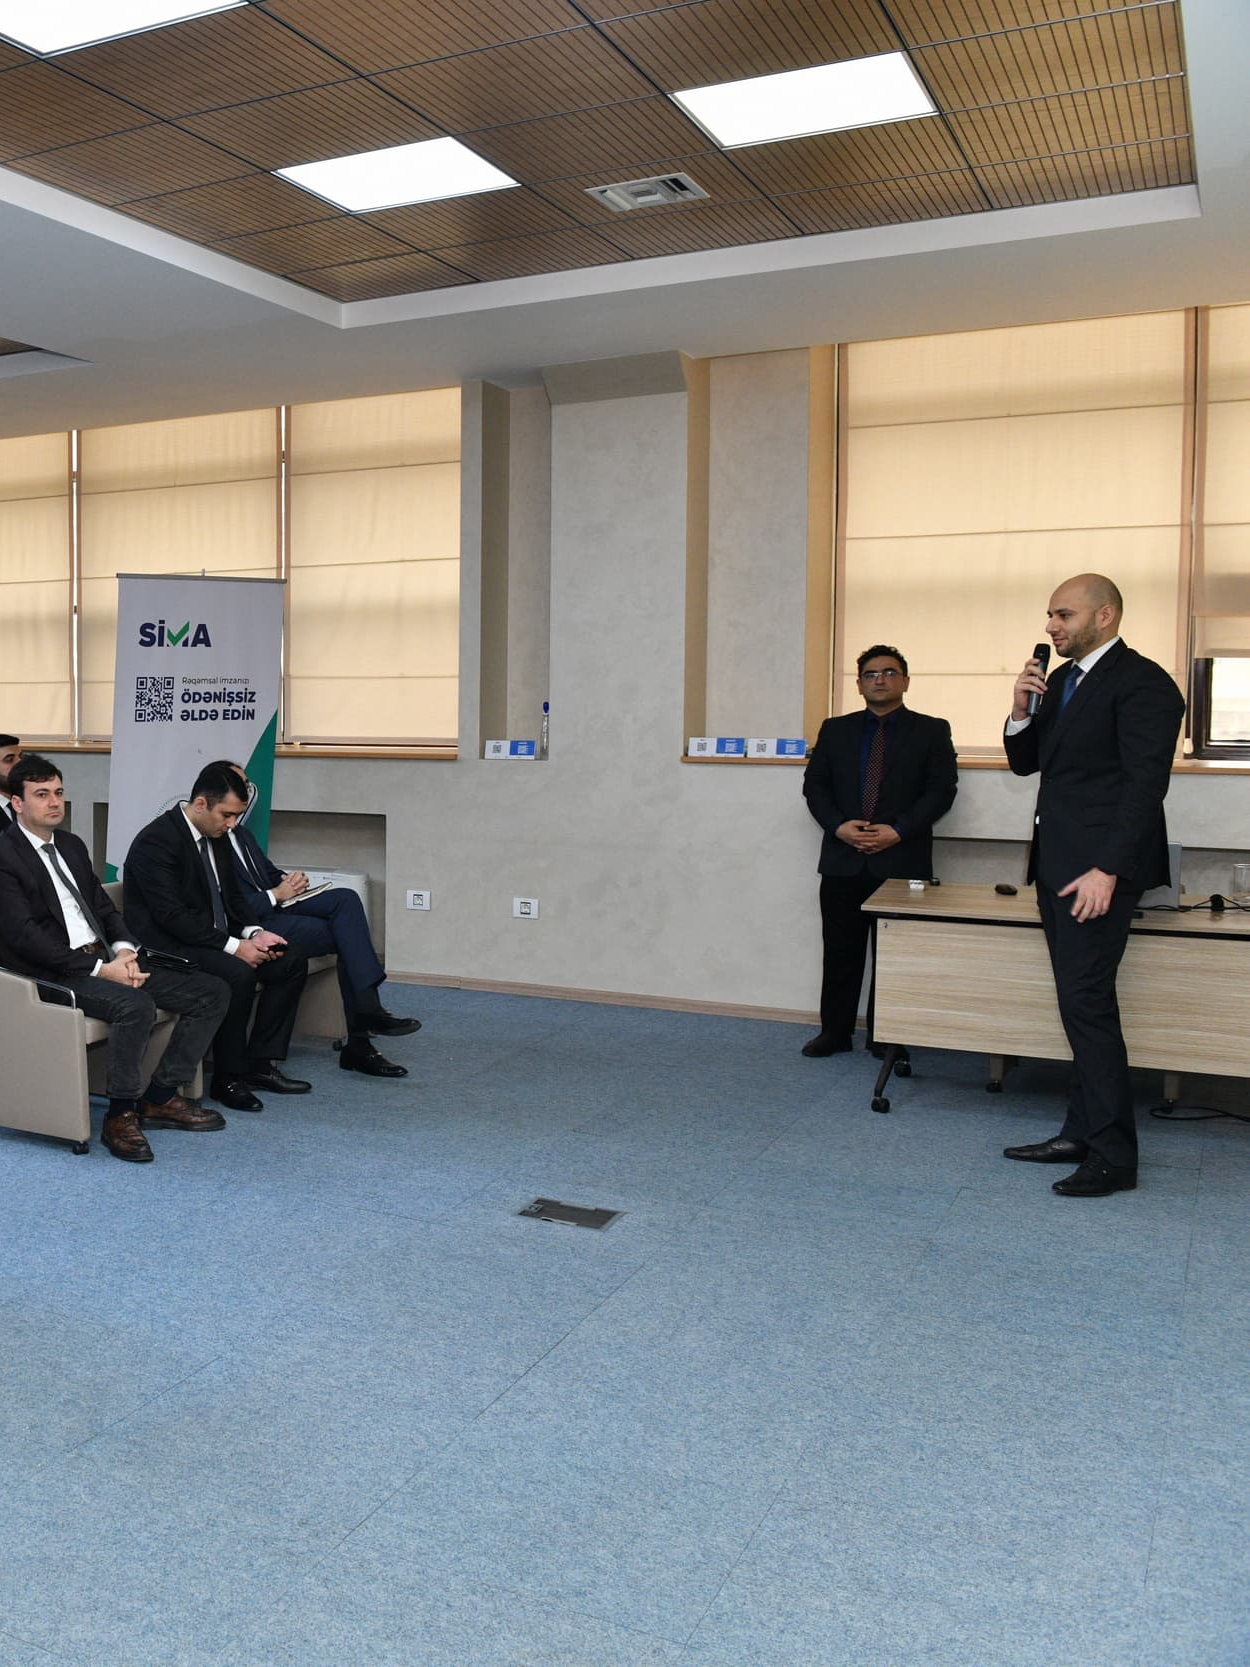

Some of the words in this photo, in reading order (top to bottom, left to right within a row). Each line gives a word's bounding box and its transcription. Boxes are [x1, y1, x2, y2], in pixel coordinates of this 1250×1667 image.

[181, 687, 256, 706] ÖDƏNİŞSİZ
[180, 709, 219, 722] ƏLDƏ
[222, 705, 255, 721] EDİN
